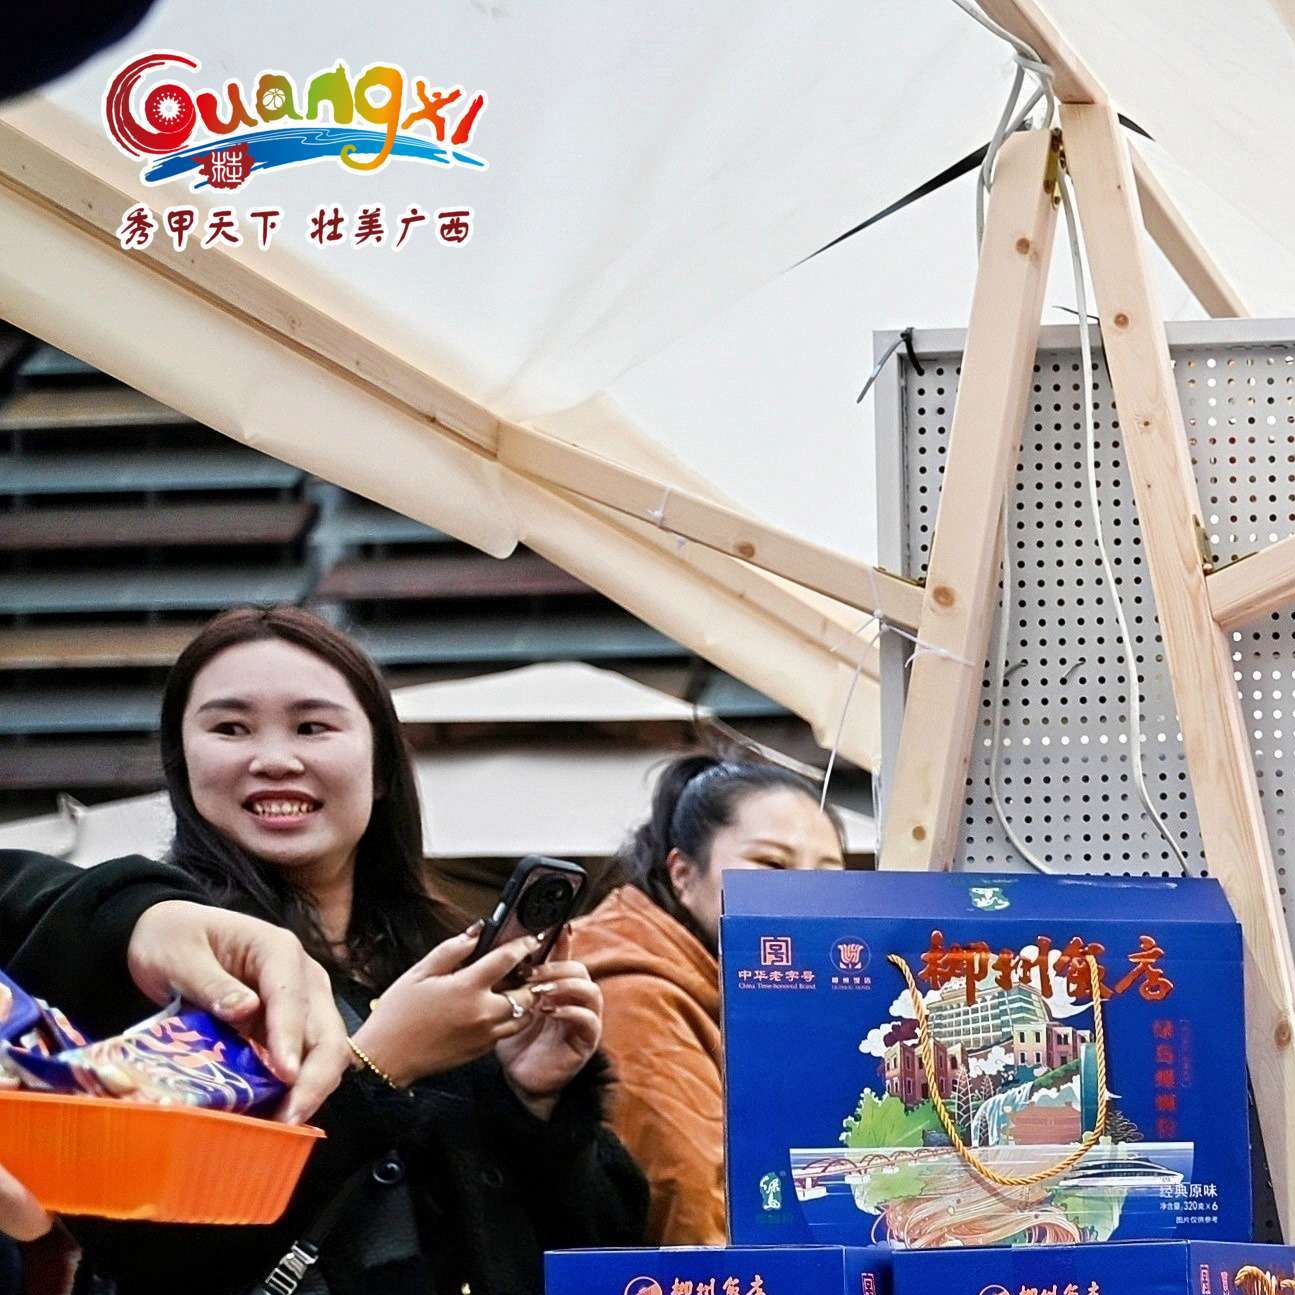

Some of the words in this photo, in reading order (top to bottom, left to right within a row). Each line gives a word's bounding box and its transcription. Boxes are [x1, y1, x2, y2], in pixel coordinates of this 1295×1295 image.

[738, 970, 815, 982] 中华老字号
[1160, 1183, 1218, 1198] 经典原味
